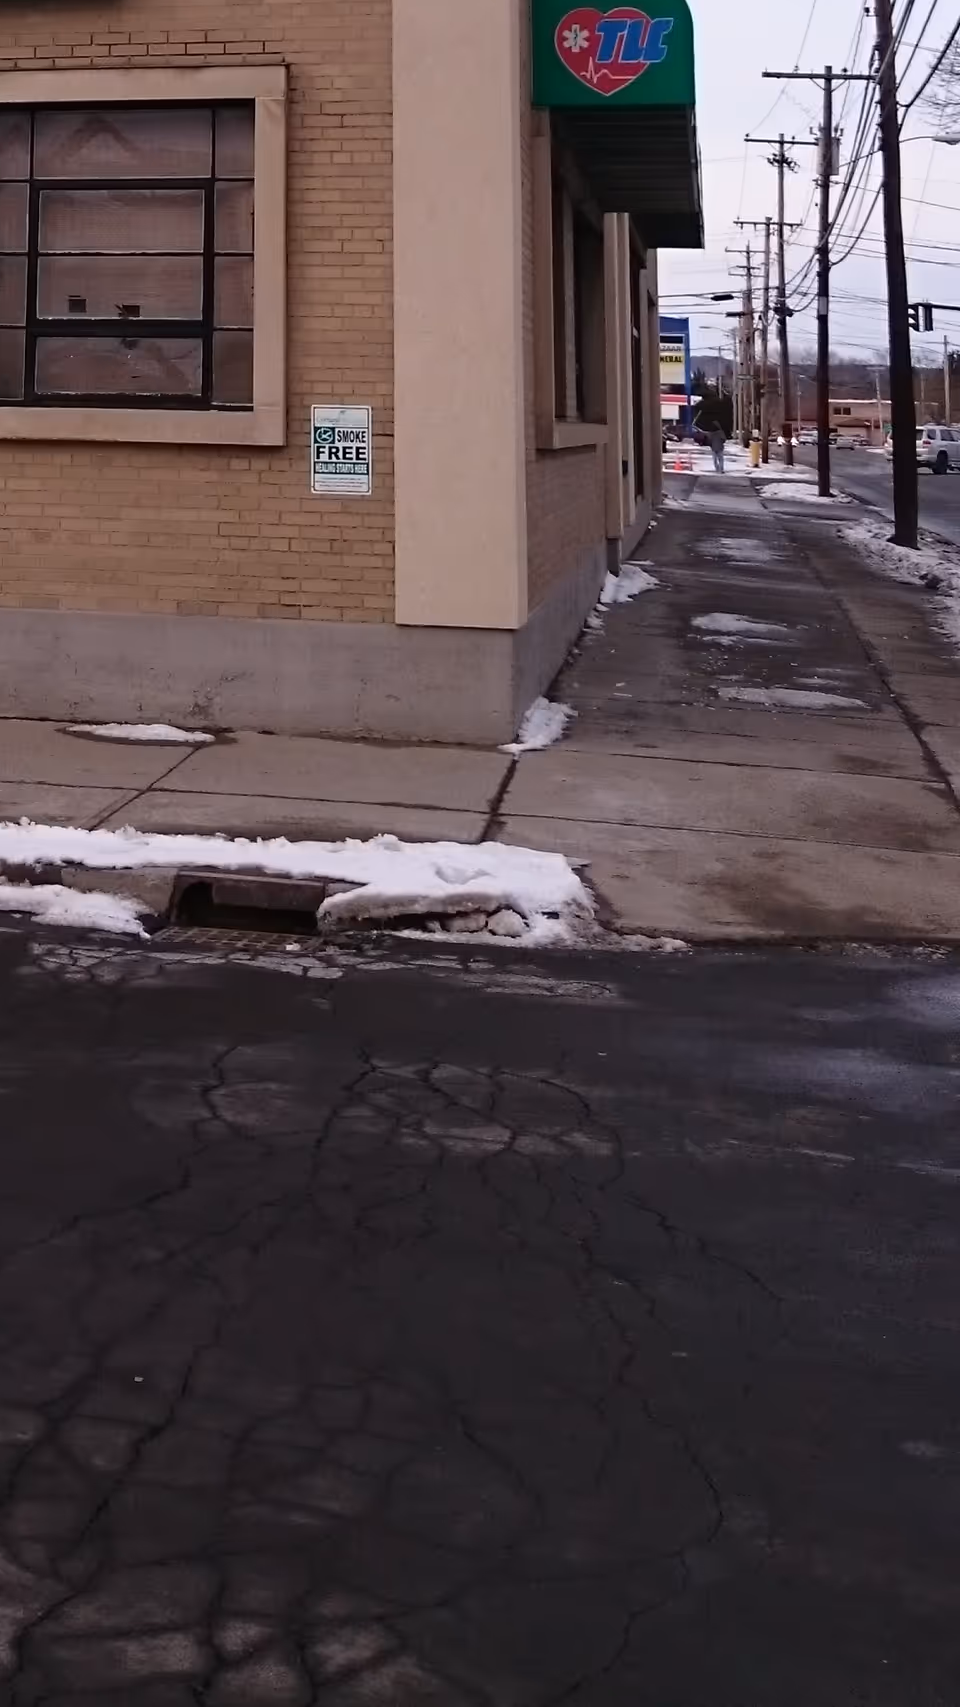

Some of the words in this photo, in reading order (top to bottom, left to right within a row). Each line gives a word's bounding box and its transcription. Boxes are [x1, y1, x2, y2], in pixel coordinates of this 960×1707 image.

[596, 18, 674, 63] TLC
[337, 430, 366, 443] SMOKE
[316, 446, 367, 461] FREE
